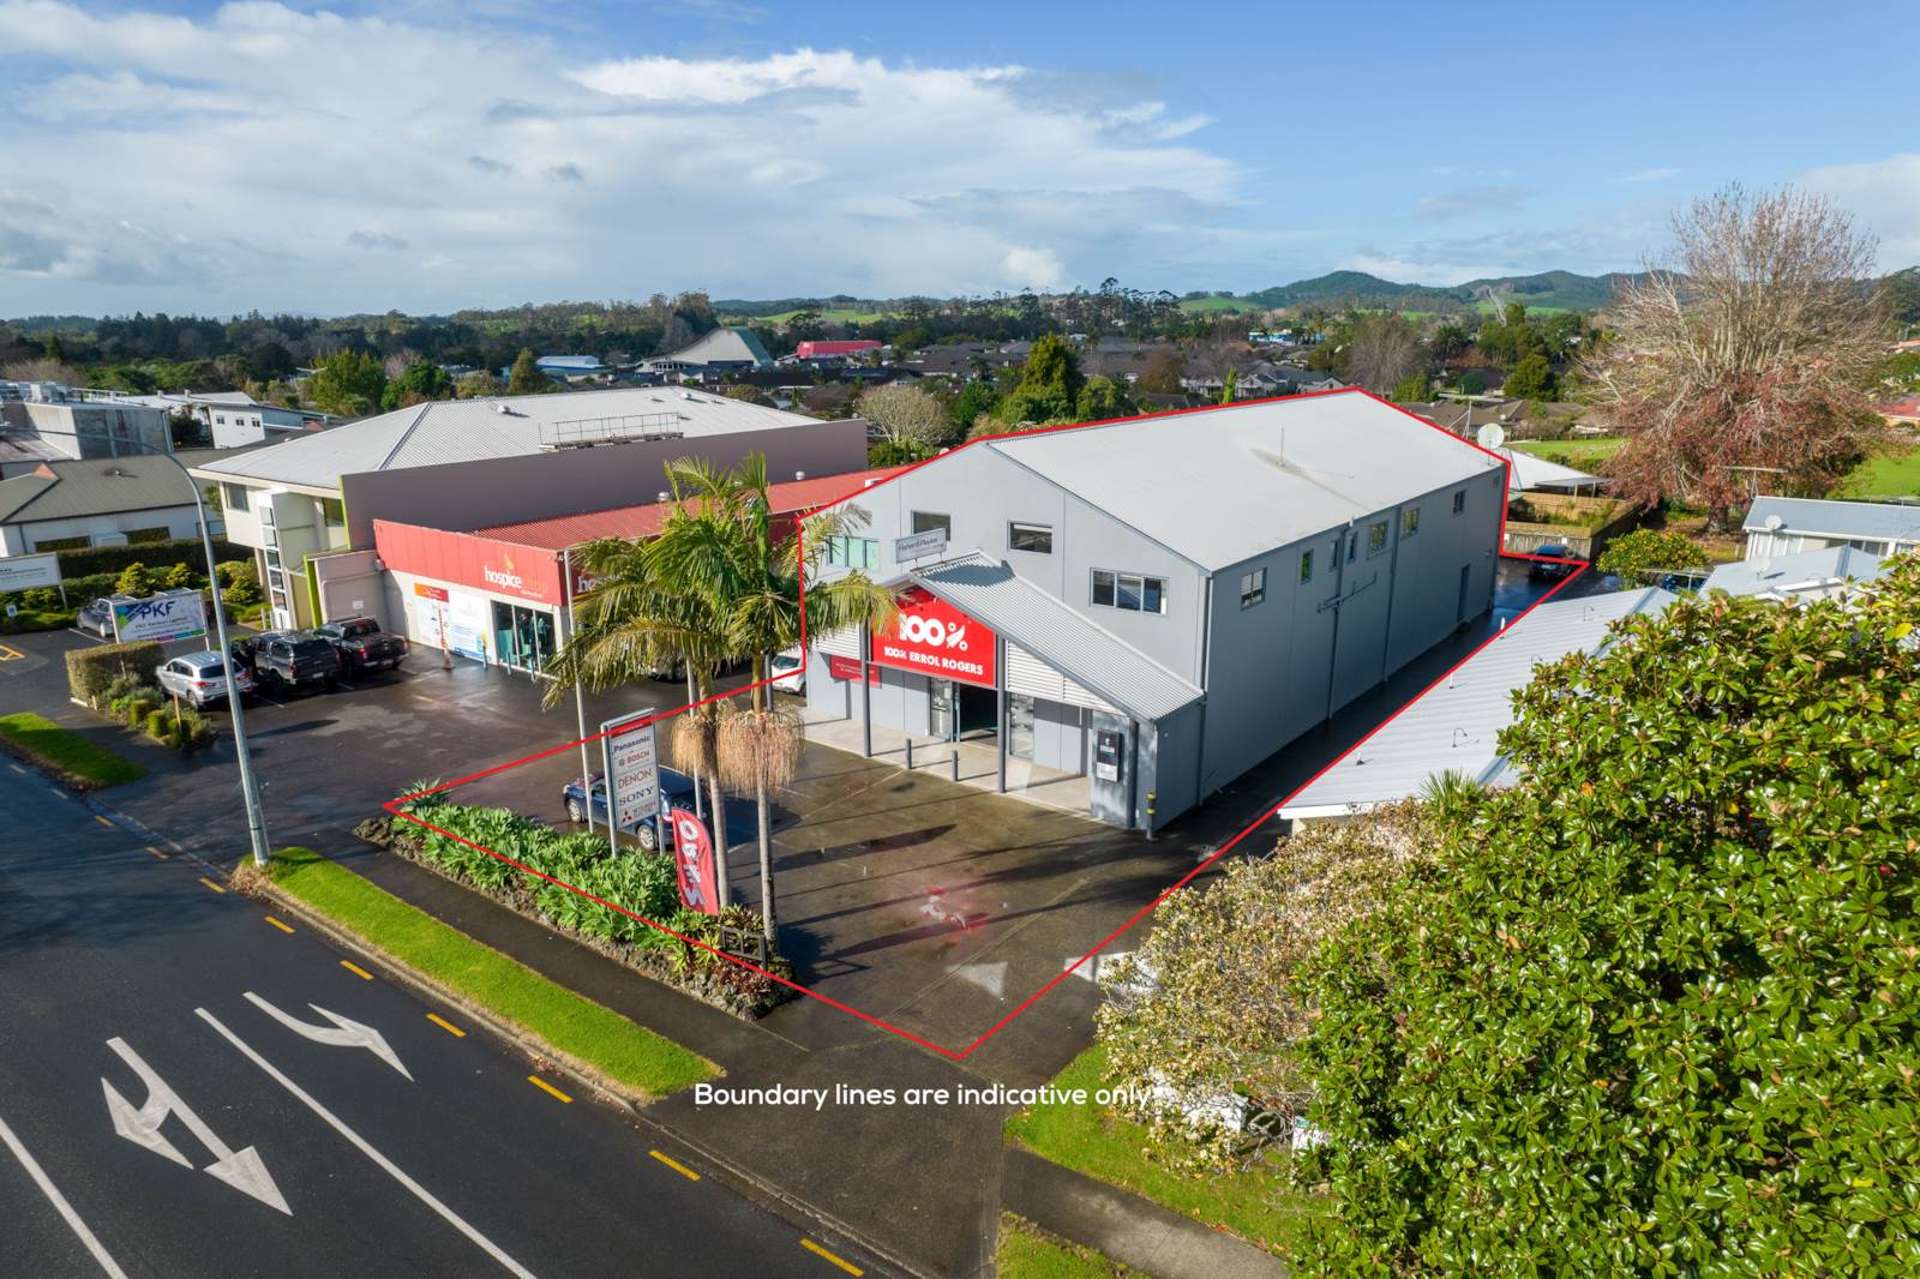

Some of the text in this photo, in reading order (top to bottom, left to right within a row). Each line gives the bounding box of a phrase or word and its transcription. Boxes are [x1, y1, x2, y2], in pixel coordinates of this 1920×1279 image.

[484, 565, 522, 588] hospice
[140, 600, 176, 620] PKF
[899, 613, 968, 651] 100%
[884, 646, 984, 676] 100% ERROL ROGERS
[613, 735, 652, 753] Panasonic
[626, 751, 650, 764] BOSCH
[618, 767, 653, 790] DENON
[619, 785, 654, 807] SONY
